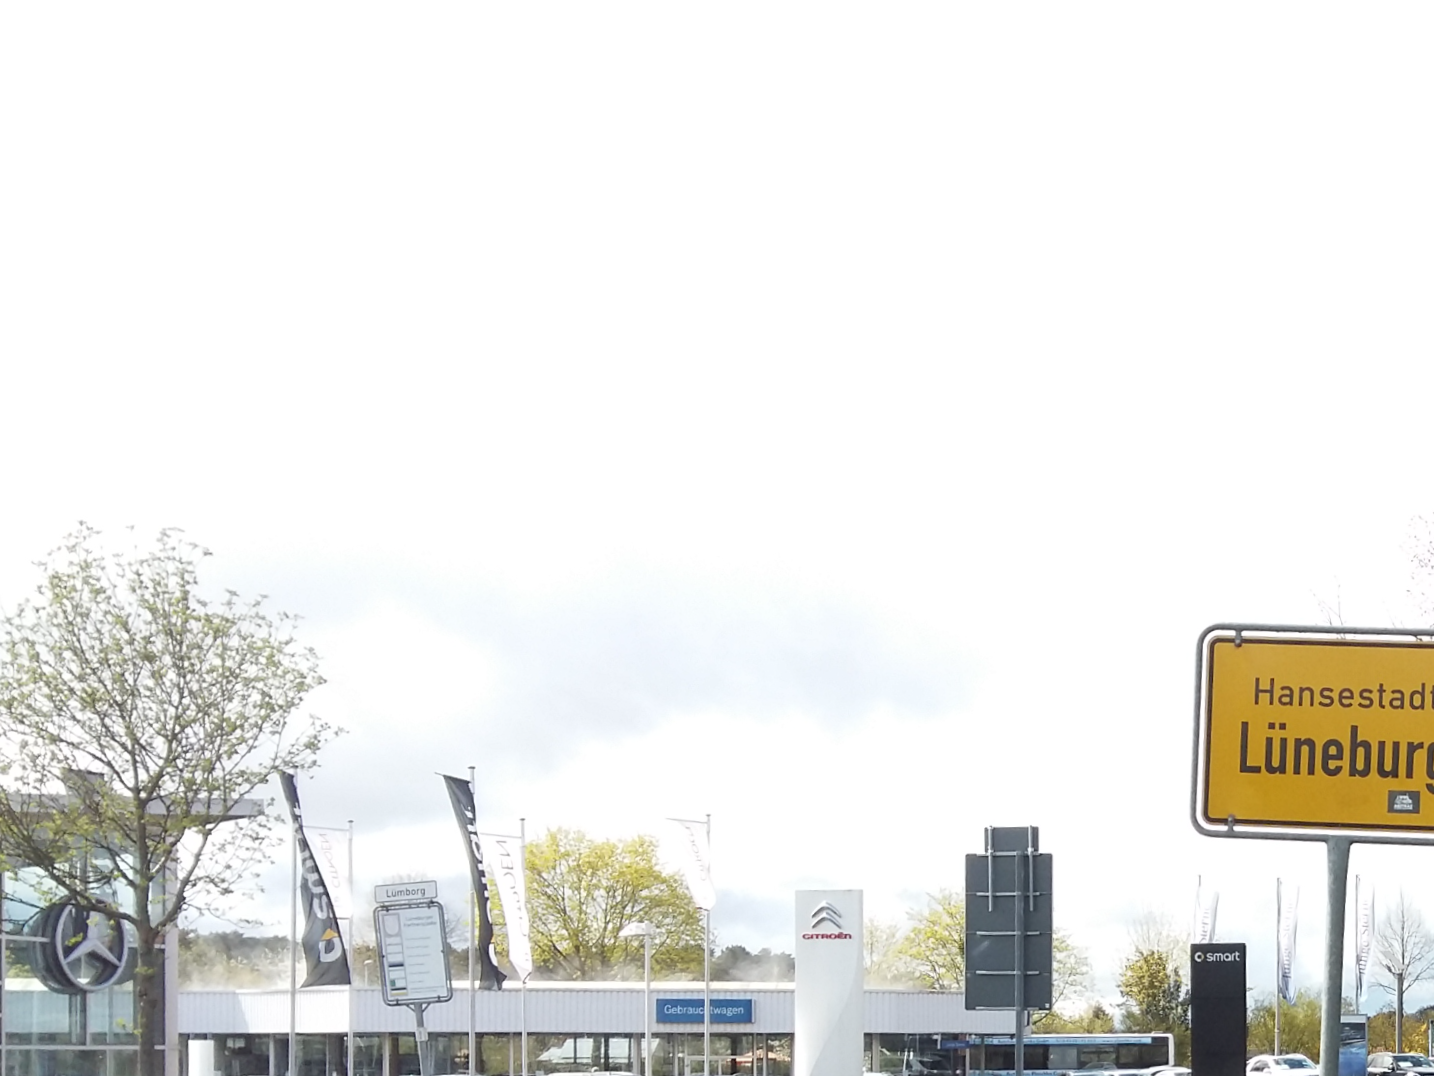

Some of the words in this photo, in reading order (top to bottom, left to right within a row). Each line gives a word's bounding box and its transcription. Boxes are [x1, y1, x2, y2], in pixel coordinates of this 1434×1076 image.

[386, 887, 426, 898] Lümborg
[1206, 951, 1240, 962] smart
[664, 1004, 744, 1017] Gebrauctwagen
